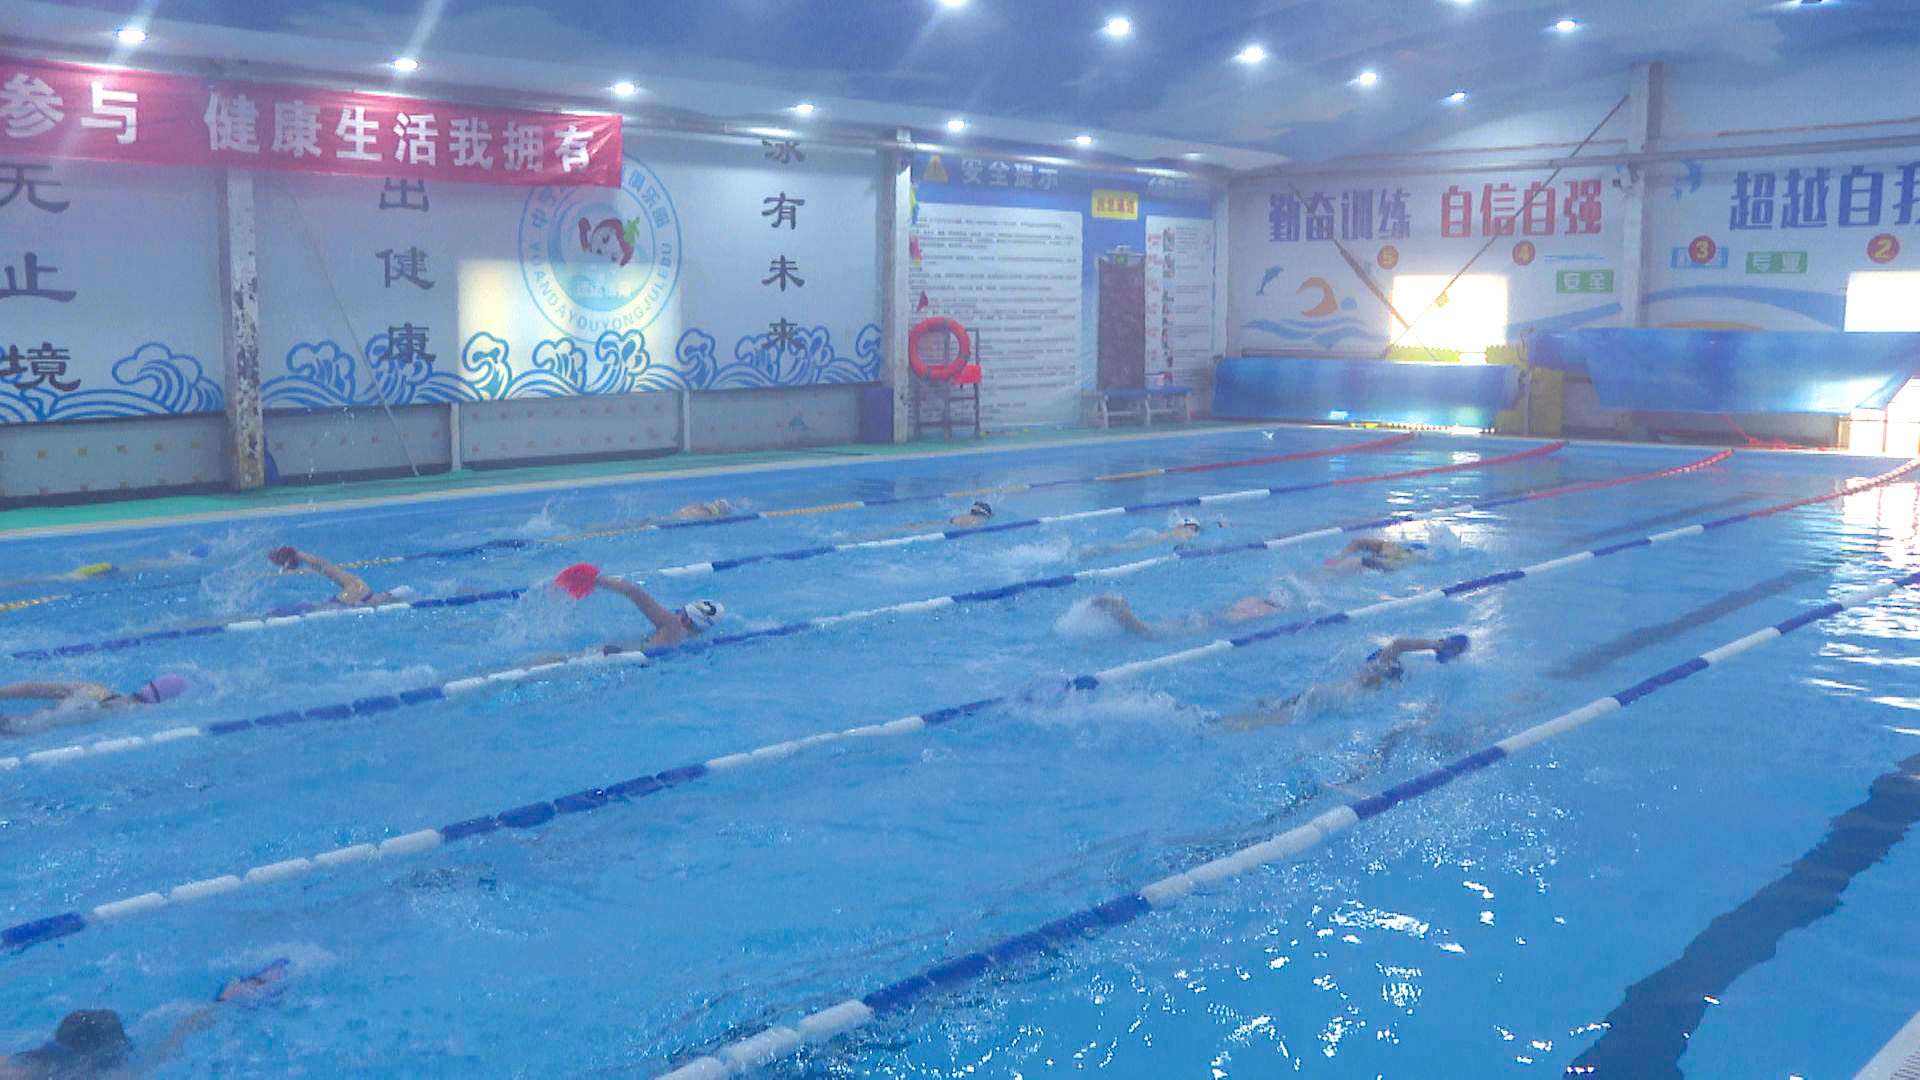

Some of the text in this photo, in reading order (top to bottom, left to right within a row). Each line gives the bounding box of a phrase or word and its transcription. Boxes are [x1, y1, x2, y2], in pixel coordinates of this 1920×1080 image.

[0, 73, 594, 173] 参与 健康生活我拥有
[1441, 179, 1602, 238] 自信自强
[1694, 239, 1709, 260] 3
[1874, 239, 1893, 259] 2
